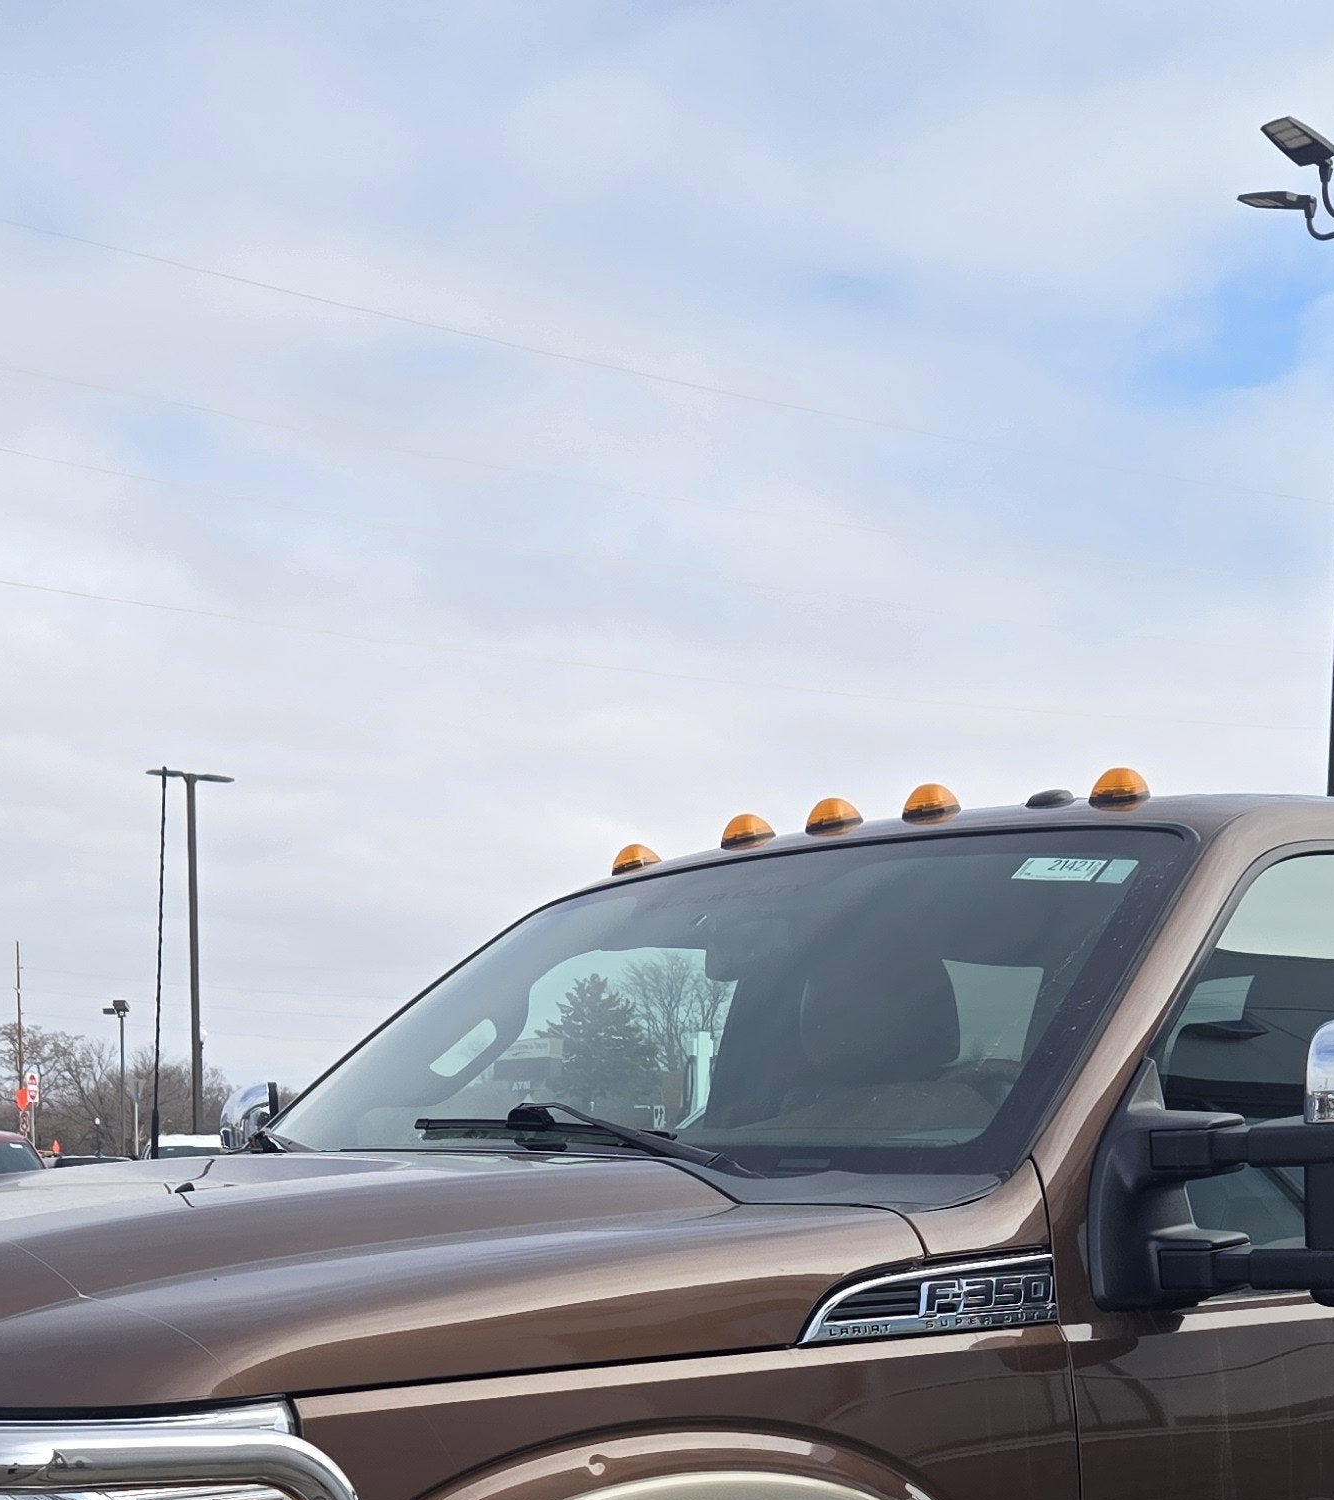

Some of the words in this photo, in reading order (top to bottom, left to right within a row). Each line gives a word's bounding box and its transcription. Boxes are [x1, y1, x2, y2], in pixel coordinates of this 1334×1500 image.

[1047, 860, 1095, 872] 21421
[918, 1273, 1053, 1319] F-350
[925, 1315, 993, 1329] SUPER
[829, 1324, 891, 1337] LARIAT
